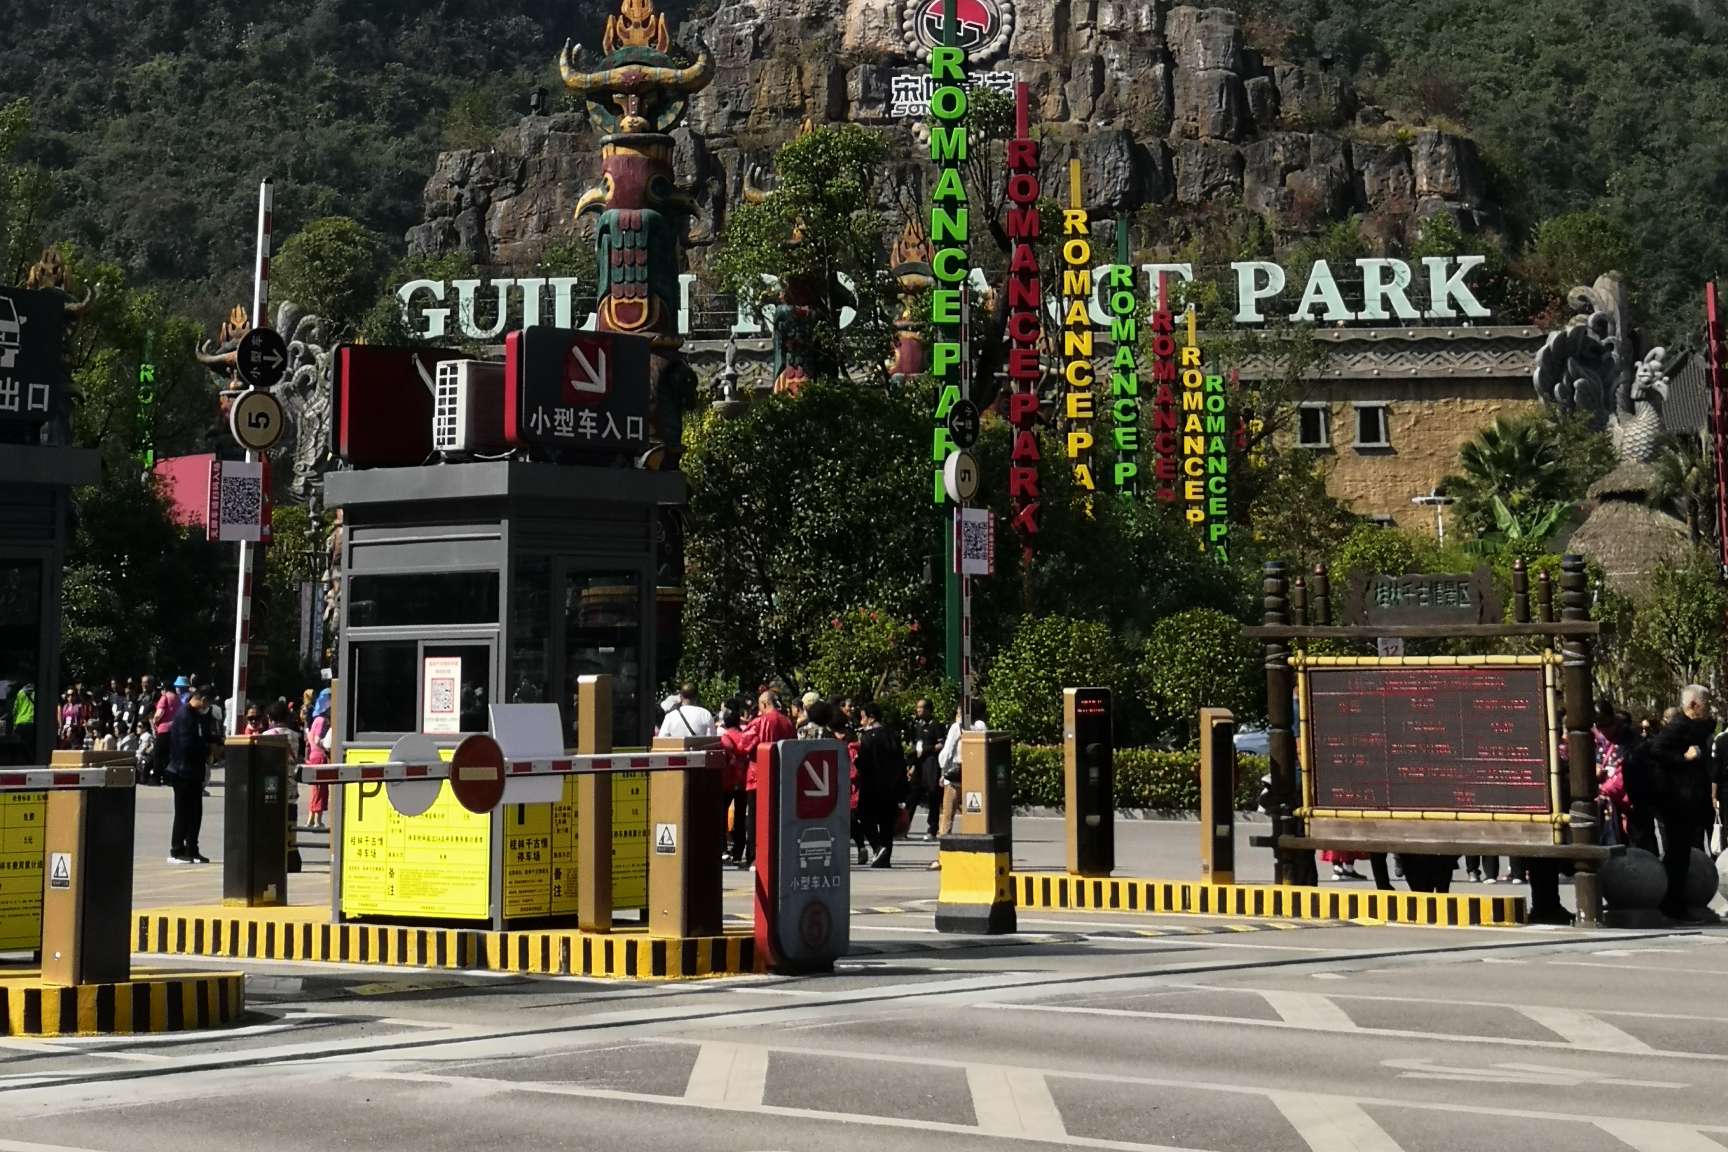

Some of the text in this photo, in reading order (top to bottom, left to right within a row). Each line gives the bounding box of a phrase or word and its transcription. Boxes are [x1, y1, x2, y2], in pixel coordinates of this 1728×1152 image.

[931, 46, 968, 325] ROMANCE
[1008, 139, 1040, 380] ROMANCE
[1064, 209, 1095, 423] ROMANCE
[1110, 264, 1137, 451] ROMANCE
[1230, 255, 1491, 323] PARK
[248, 412, 270, 429] 5
[530, 406, 643, 440] 小型车入口
[1152, 311, 1177, 481] ROMANCE
[1182, 346, 1205, 500] ROMANCE
[1206, 374, 1227, 516] ROMANCE
[791, 875, 841, 890] 小型车入口
